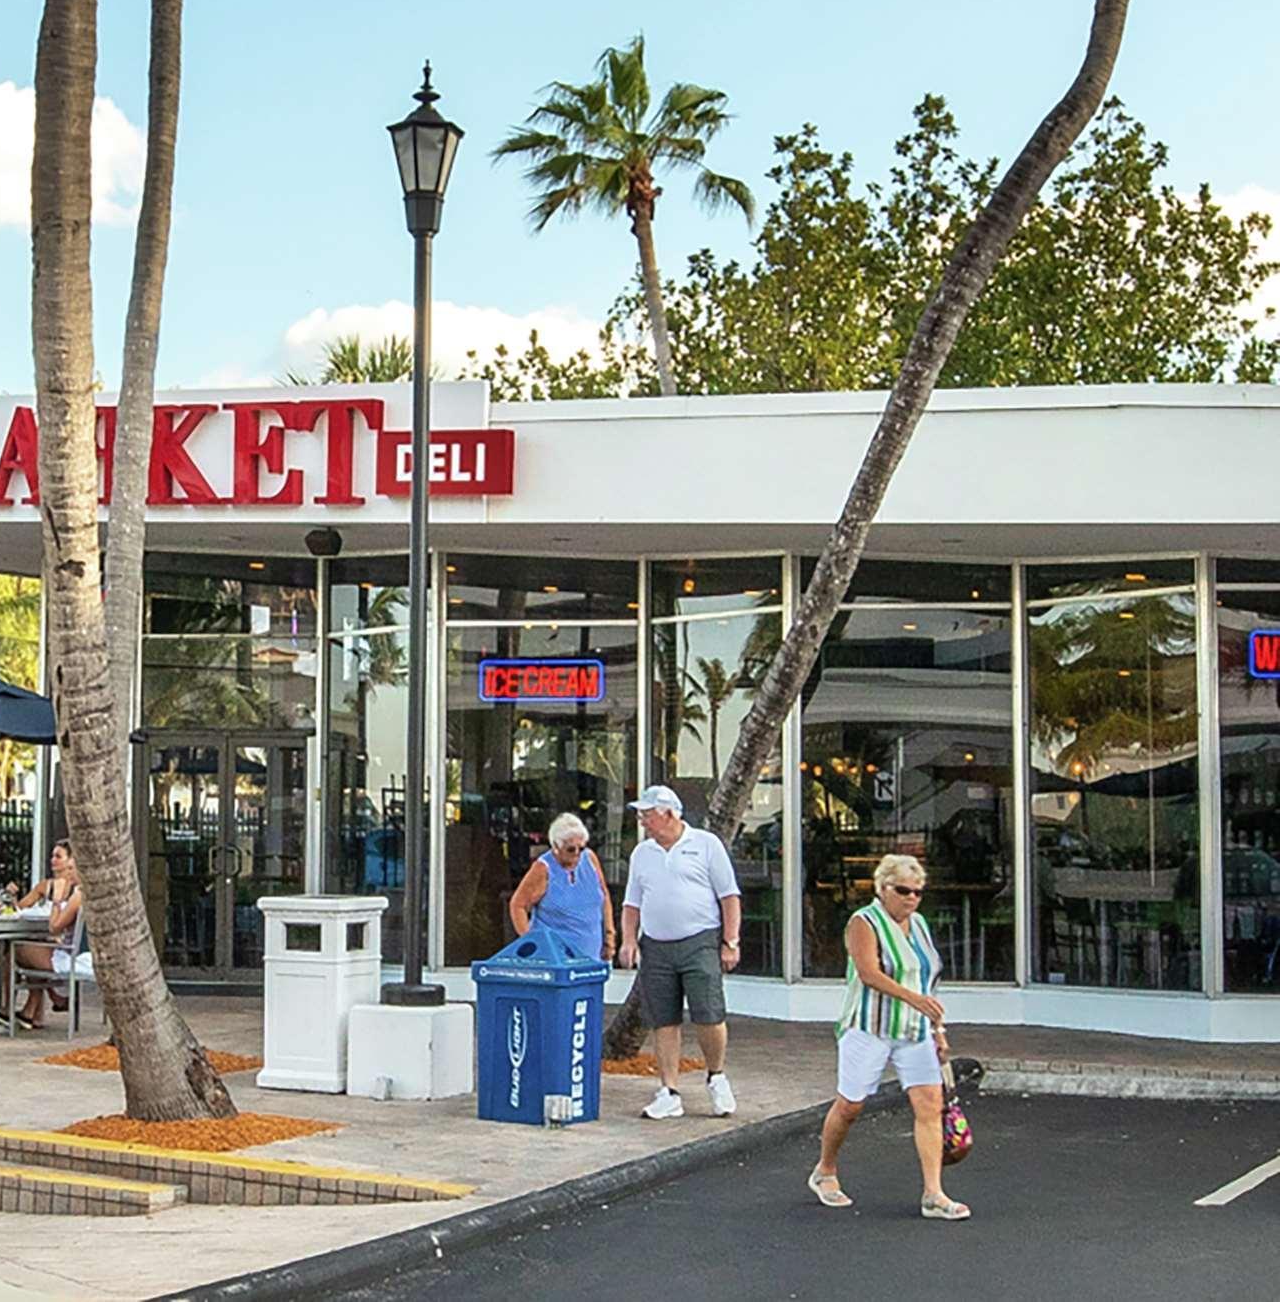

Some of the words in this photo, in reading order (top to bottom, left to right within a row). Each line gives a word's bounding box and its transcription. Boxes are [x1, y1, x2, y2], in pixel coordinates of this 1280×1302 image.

[396, 443, 486, 482] DELI
[484, 667, 520, 698] ICE
[523, 665, 599, 698] CREAM
[512, 1005, 523, 1063] LIGHT
[571, 999, 589, 1118] RECYCLE
[509, 1068, 522, 1109] BUD
